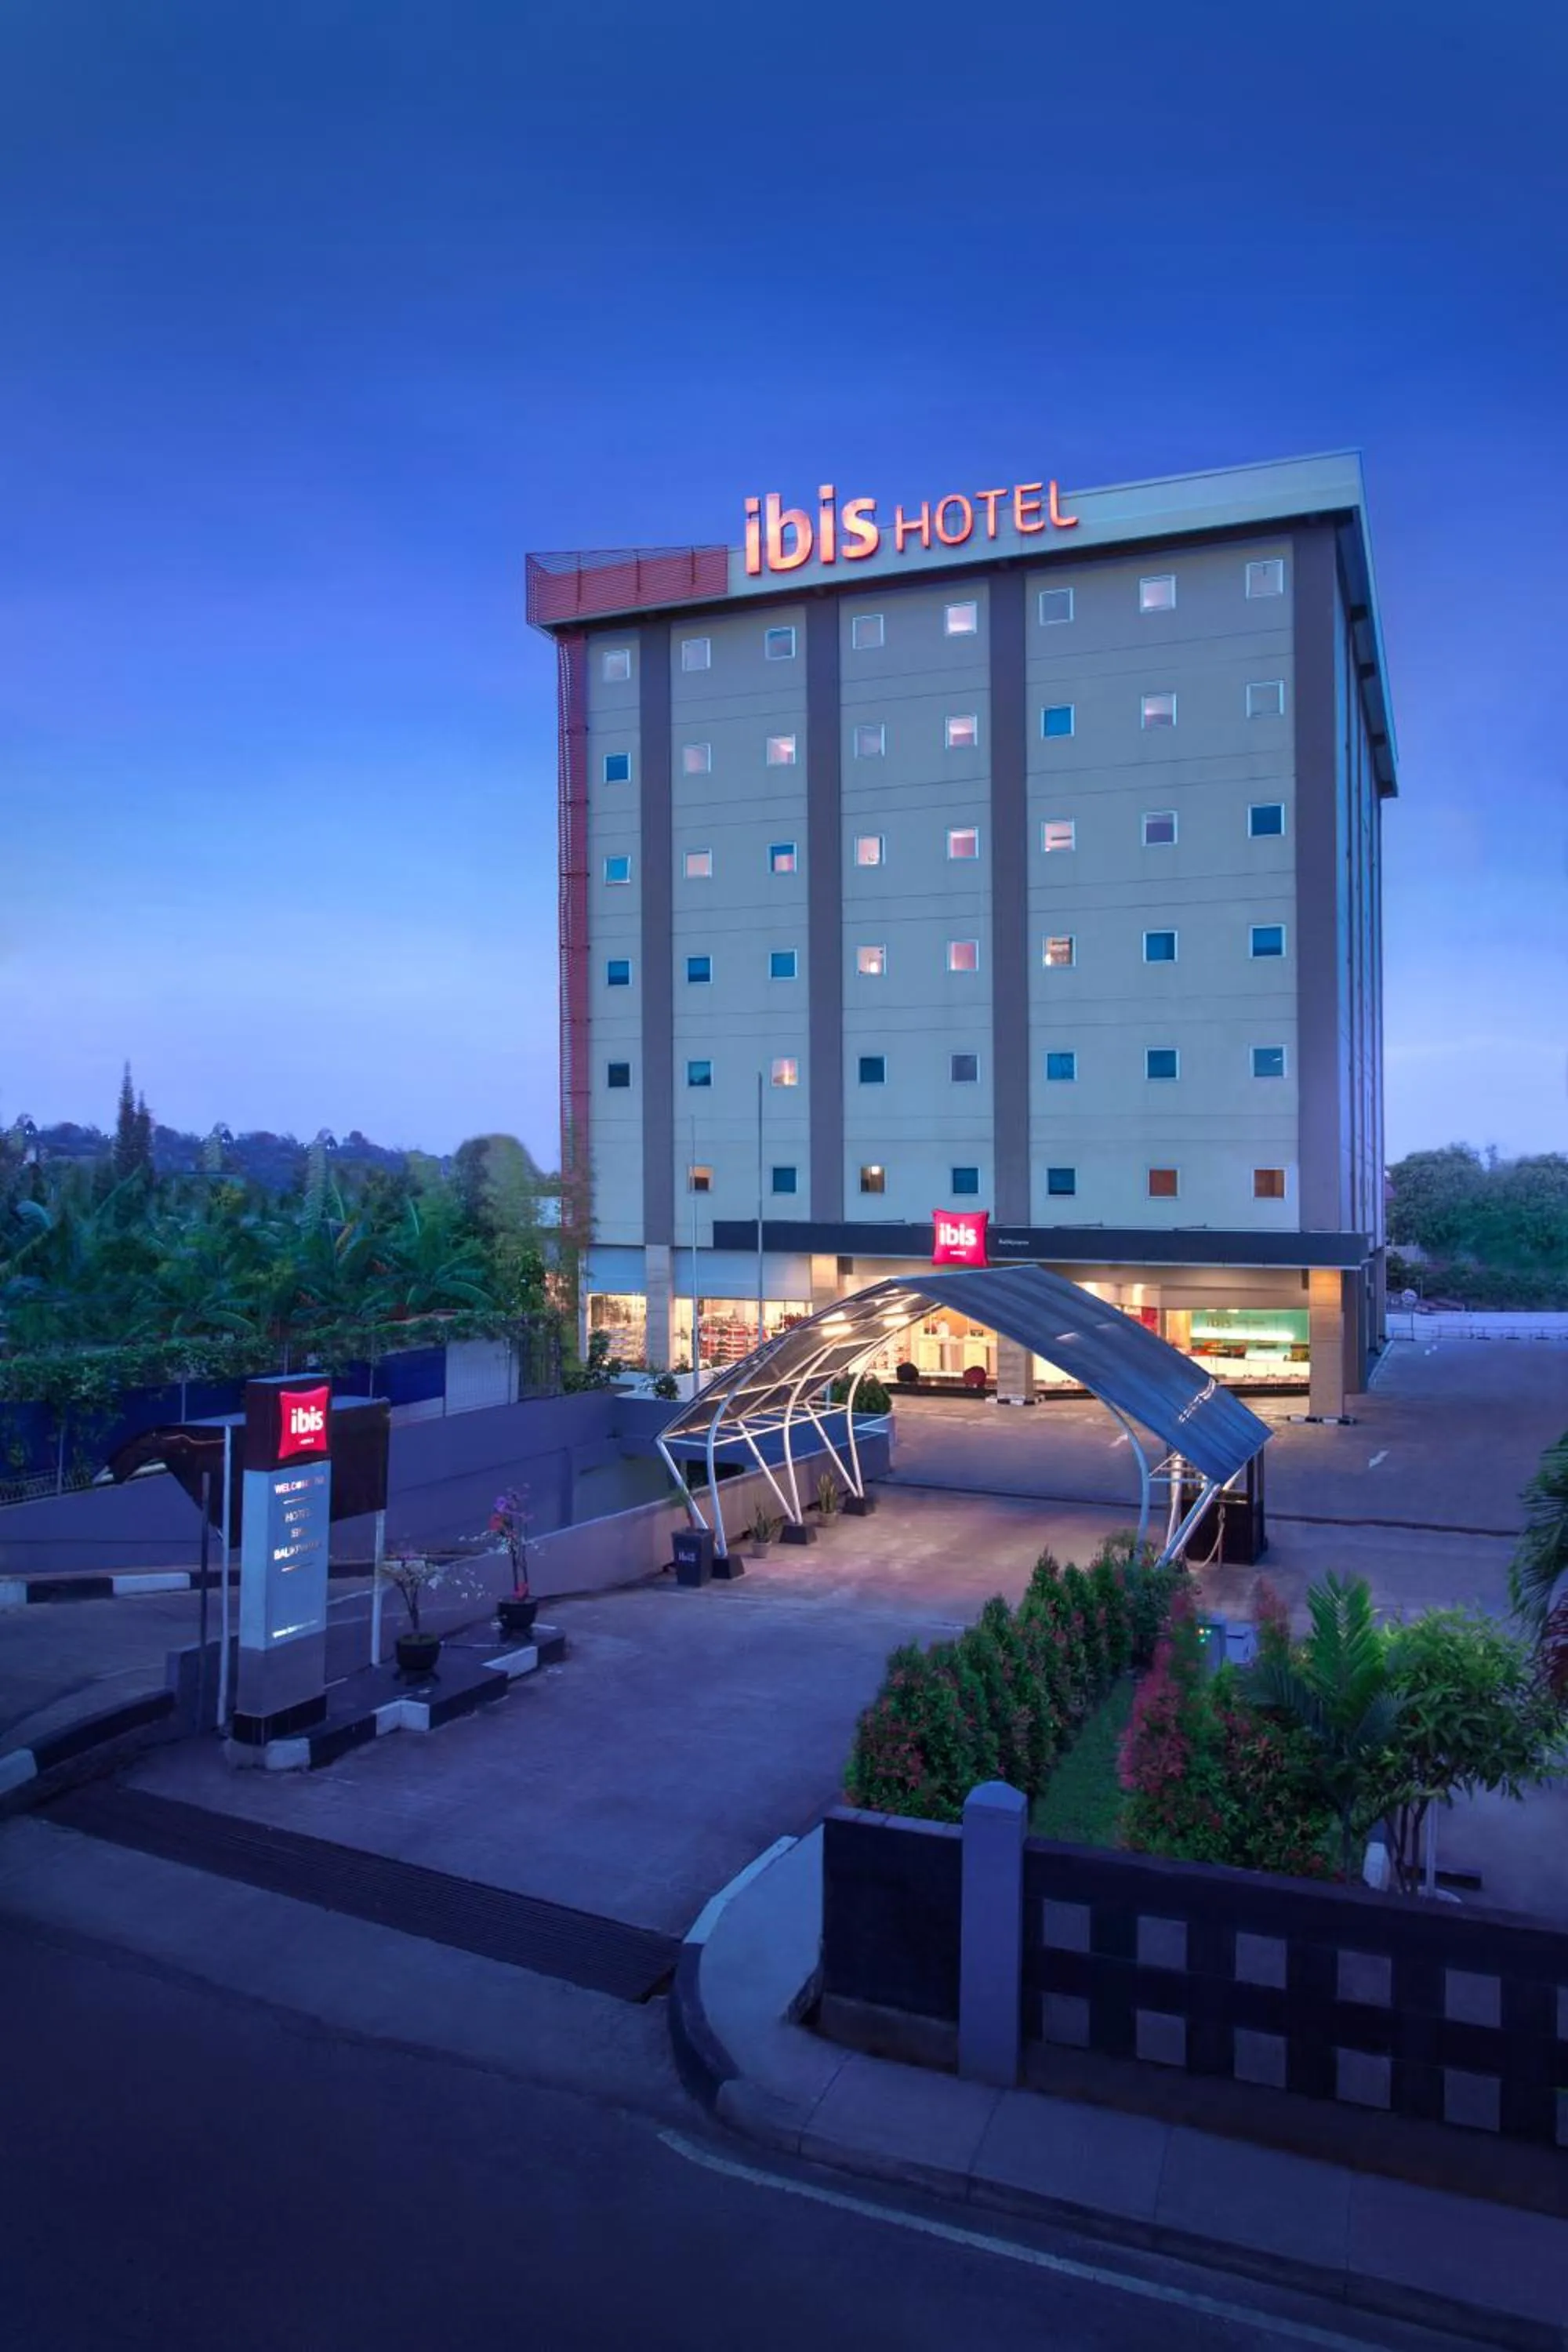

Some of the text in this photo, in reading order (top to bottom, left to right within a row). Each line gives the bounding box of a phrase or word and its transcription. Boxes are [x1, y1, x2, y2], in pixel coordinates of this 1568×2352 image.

[744, 479, 1079, 575] ibis HOTEL
[938, 1222, 978, 1246] ibis
[290, 1405, 324, 1434] ibis
